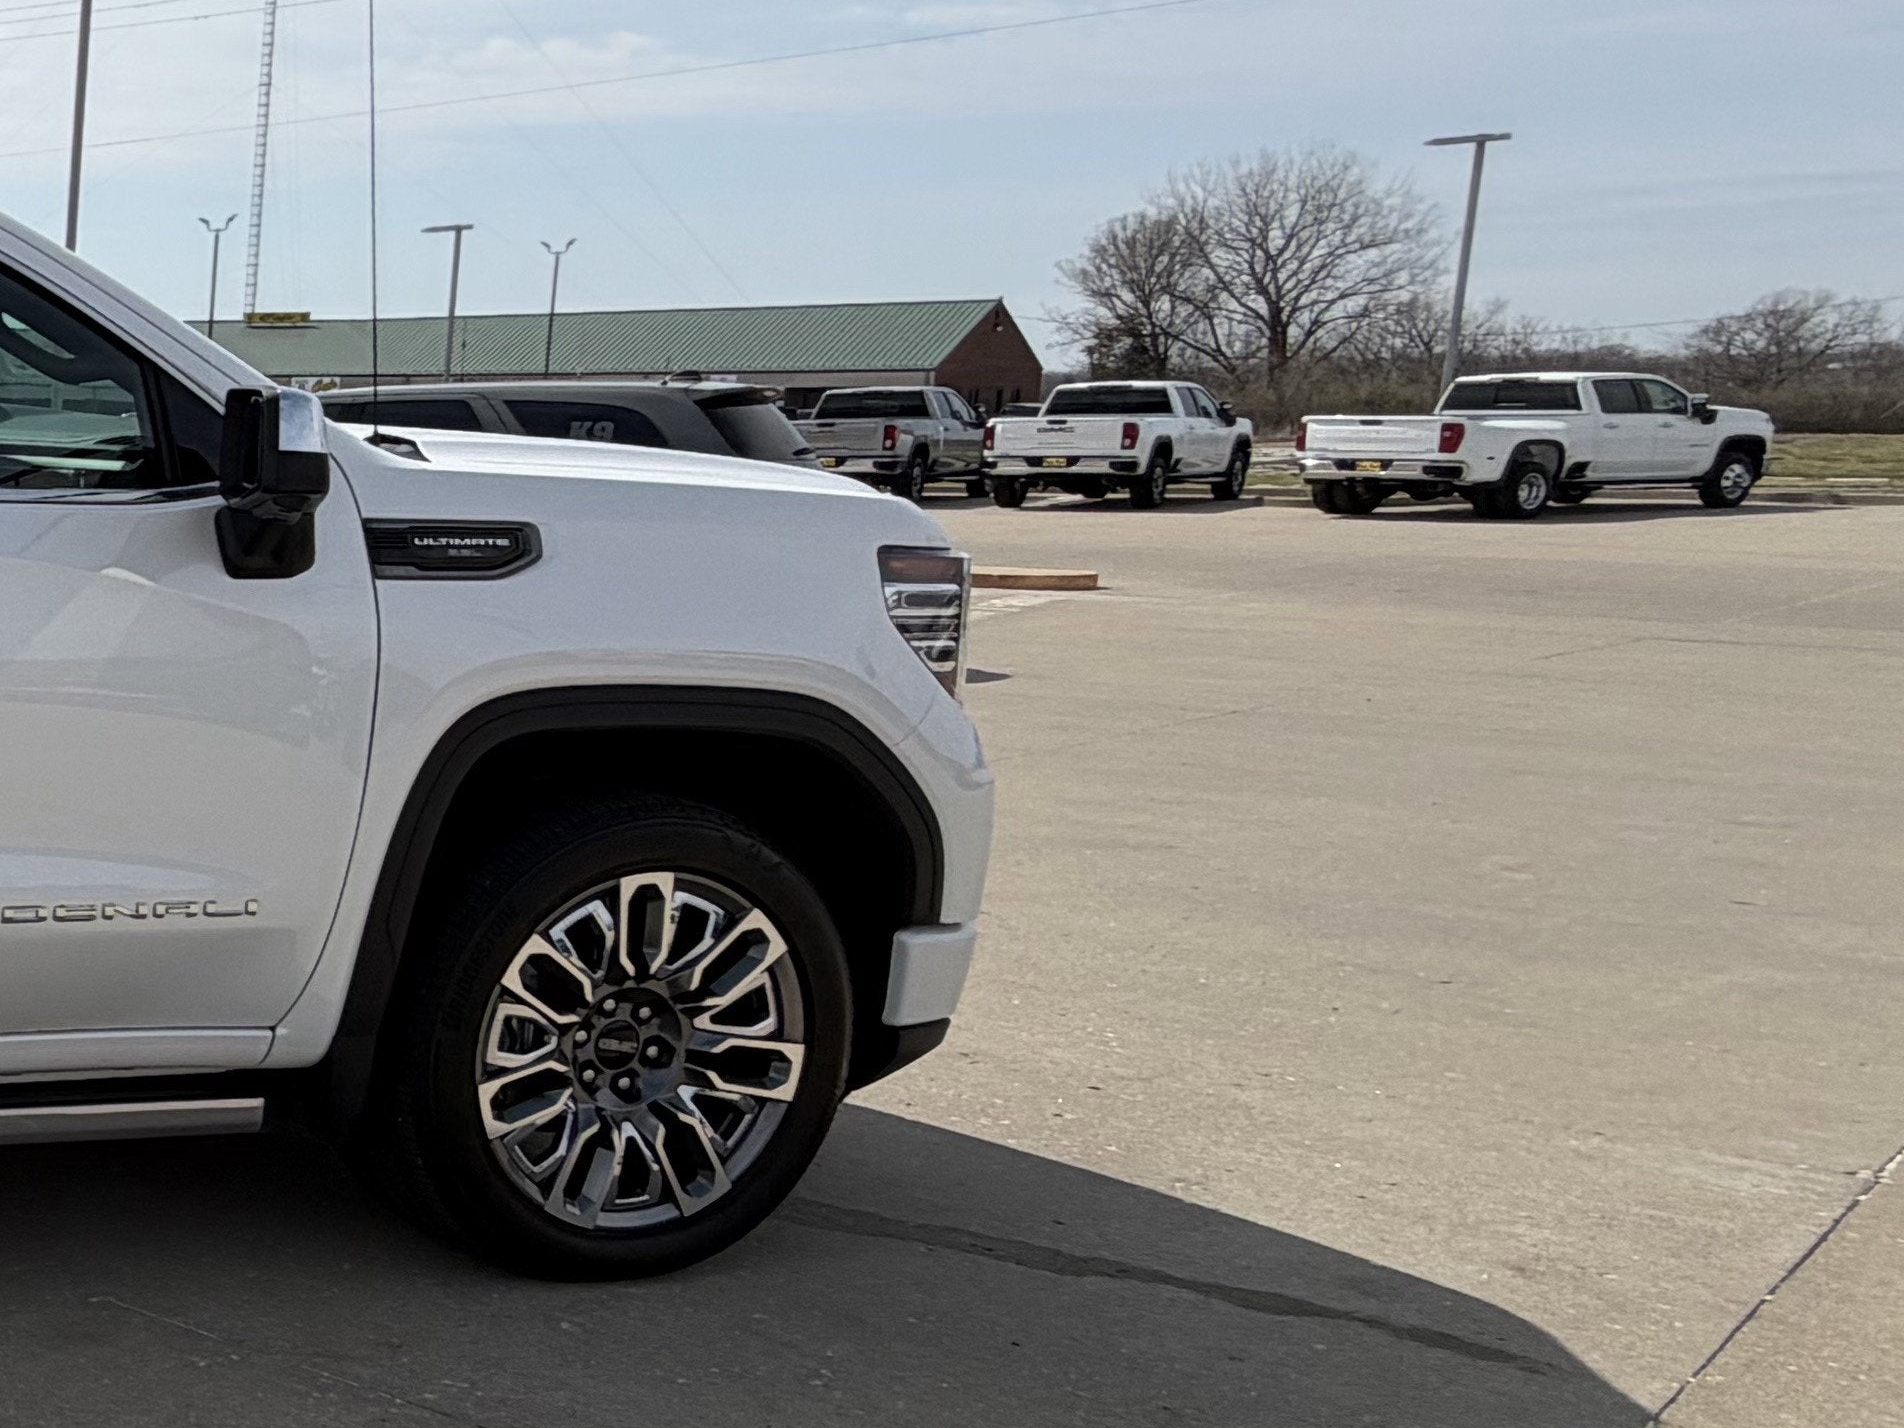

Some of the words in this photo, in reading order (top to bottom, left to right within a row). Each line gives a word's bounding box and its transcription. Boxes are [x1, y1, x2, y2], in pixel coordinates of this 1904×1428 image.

[569, 420, 615, 440] K9
[414, 537, 511, 546] ULTIMATE
[0, 898, 260, 924] DENALI
